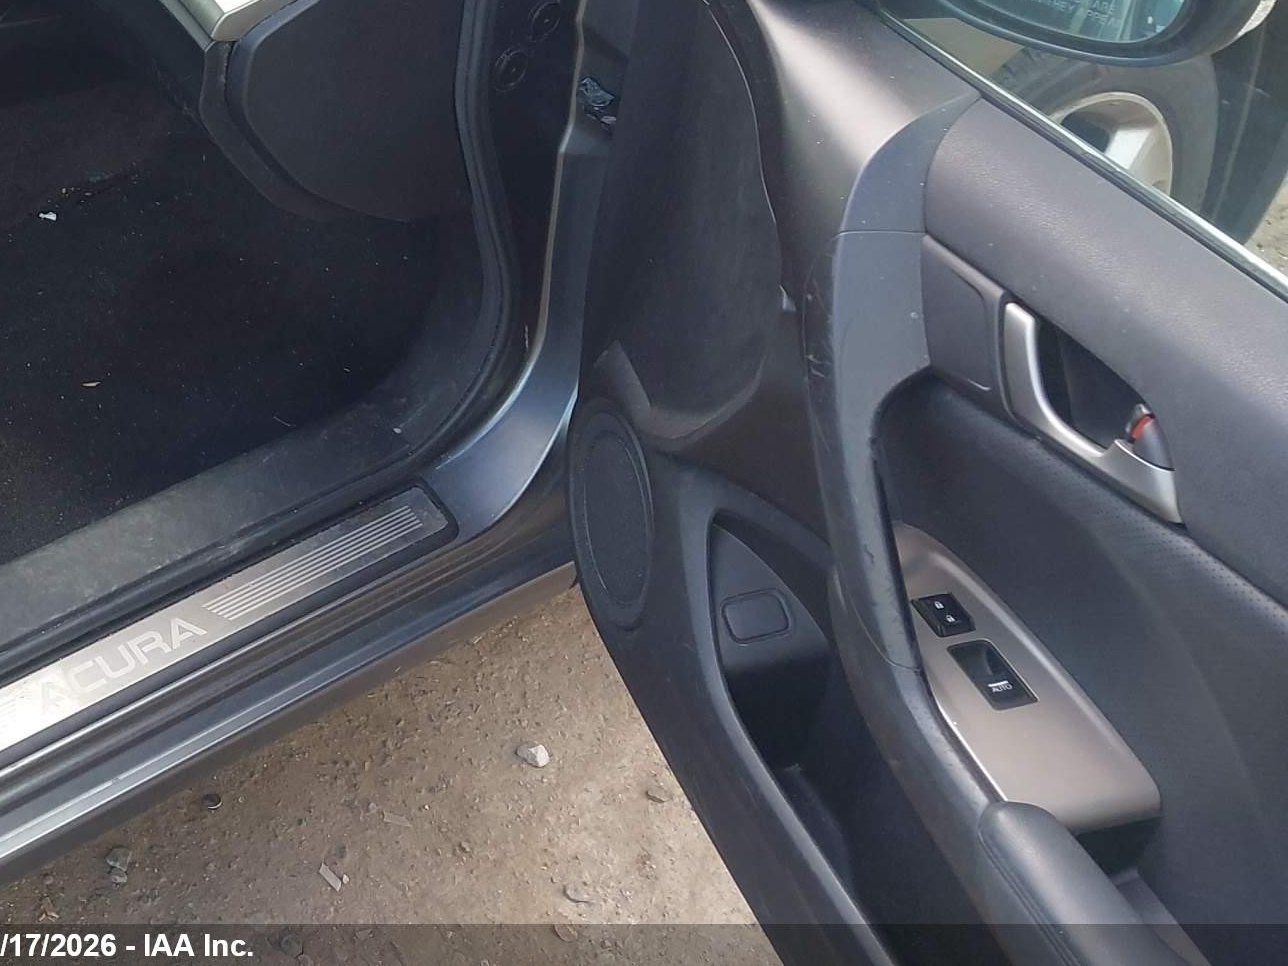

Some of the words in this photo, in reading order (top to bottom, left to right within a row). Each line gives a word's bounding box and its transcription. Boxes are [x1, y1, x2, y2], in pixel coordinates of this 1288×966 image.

[1079, 6, 1122, 28] PPEAR
[1092, 0, 1115, 15] ARE
[40, 617, 208, 715] ACURA
